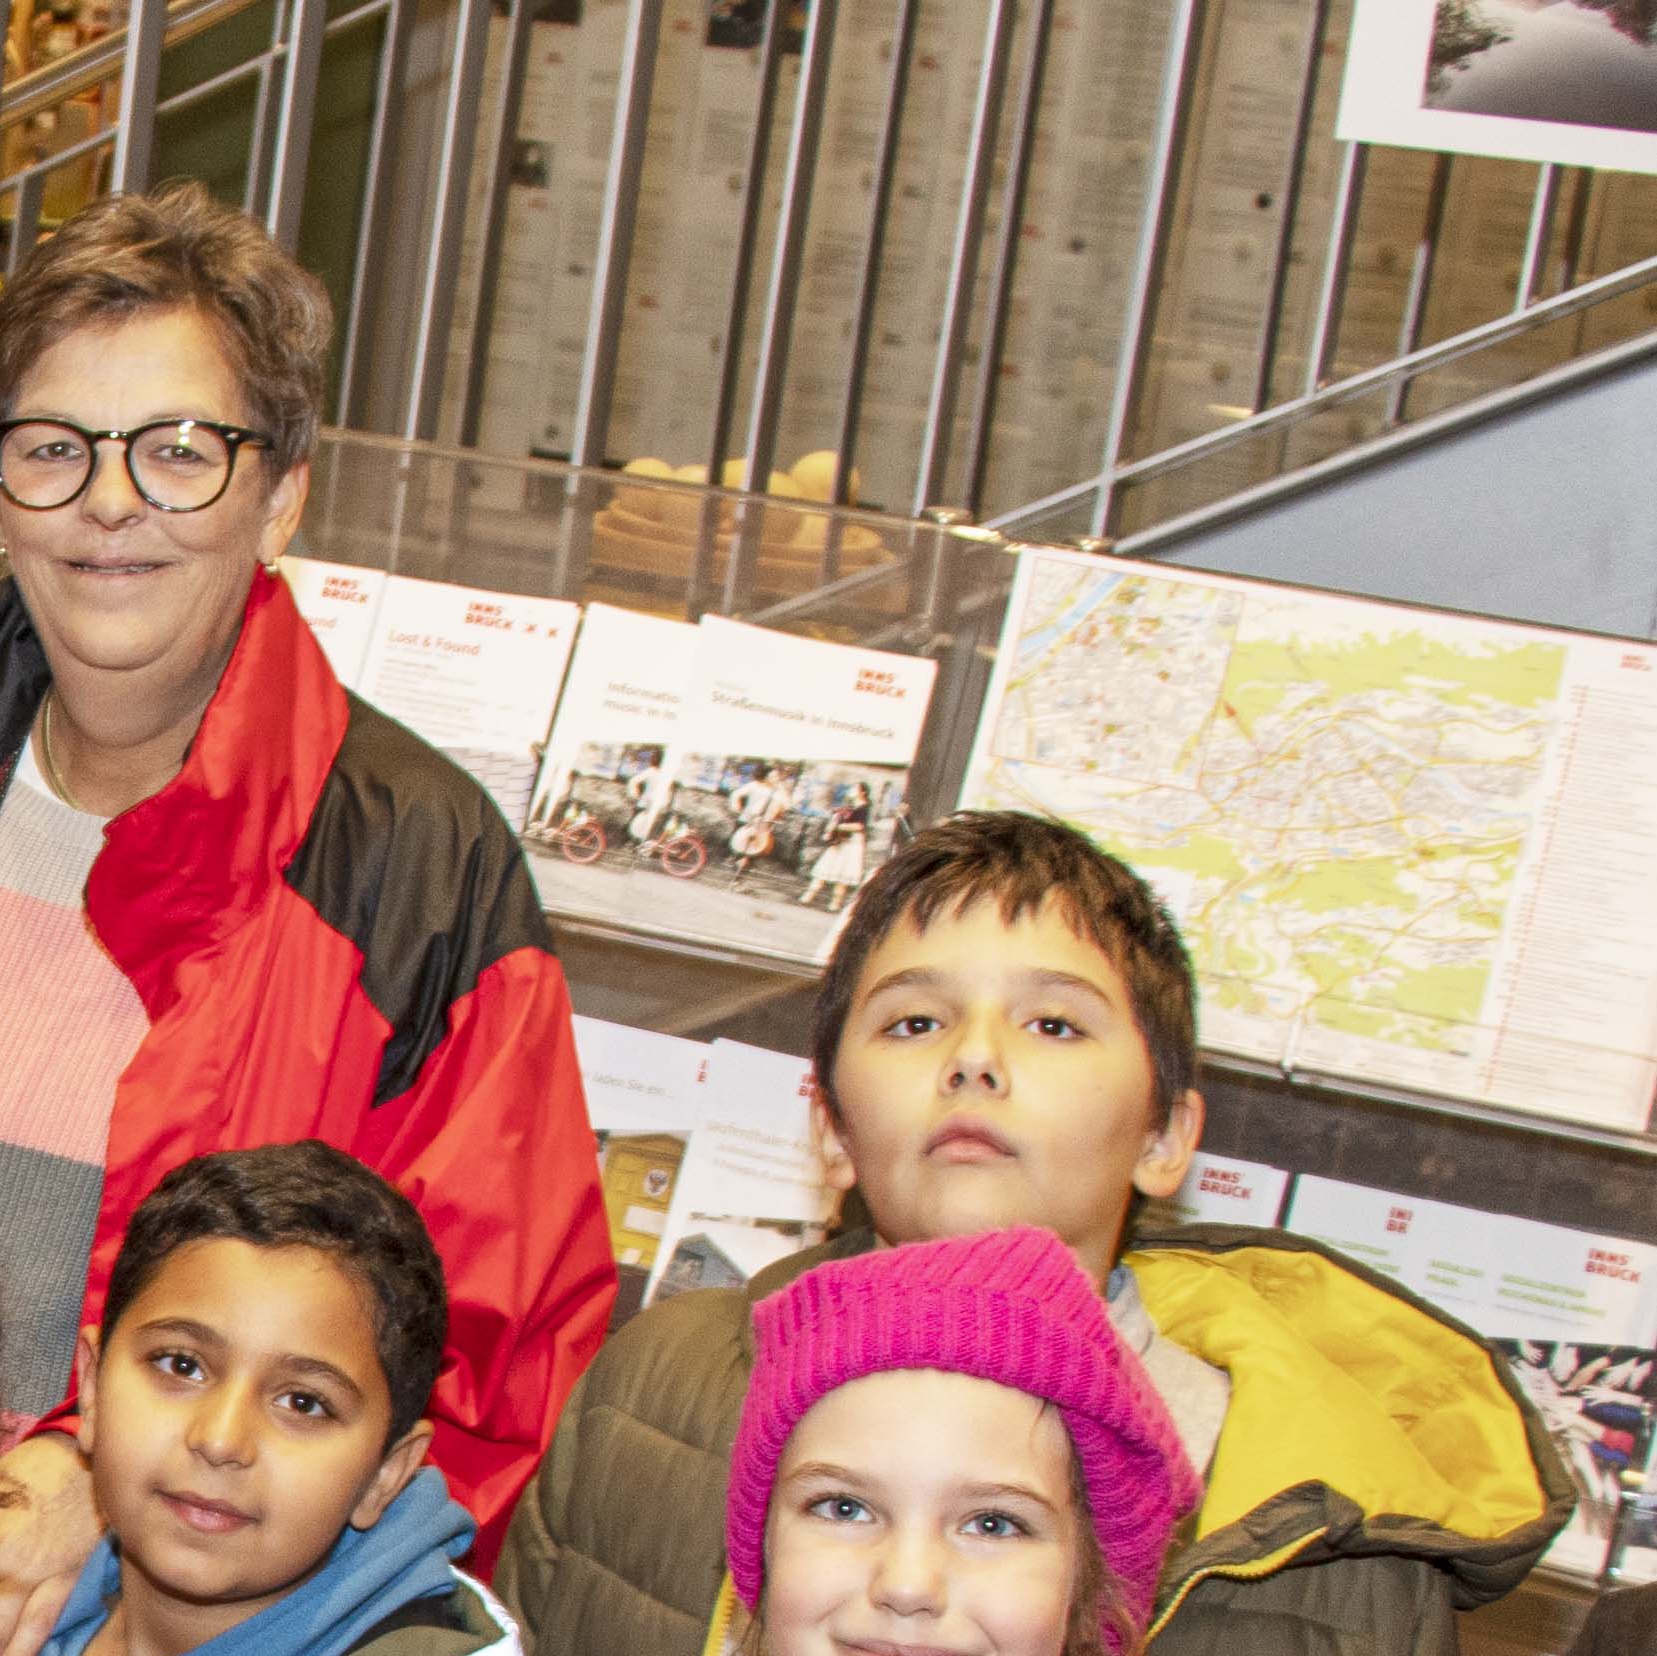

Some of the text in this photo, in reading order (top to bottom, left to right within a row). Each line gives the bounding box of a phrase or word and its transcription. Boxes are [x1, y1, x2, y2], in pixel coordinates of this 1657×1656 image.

[606, 680, 681, 704] Informatio
[1198, 1179, 1253, 1200] BRUCK
[1583, 1259, 1642, 1284] BRUCK
